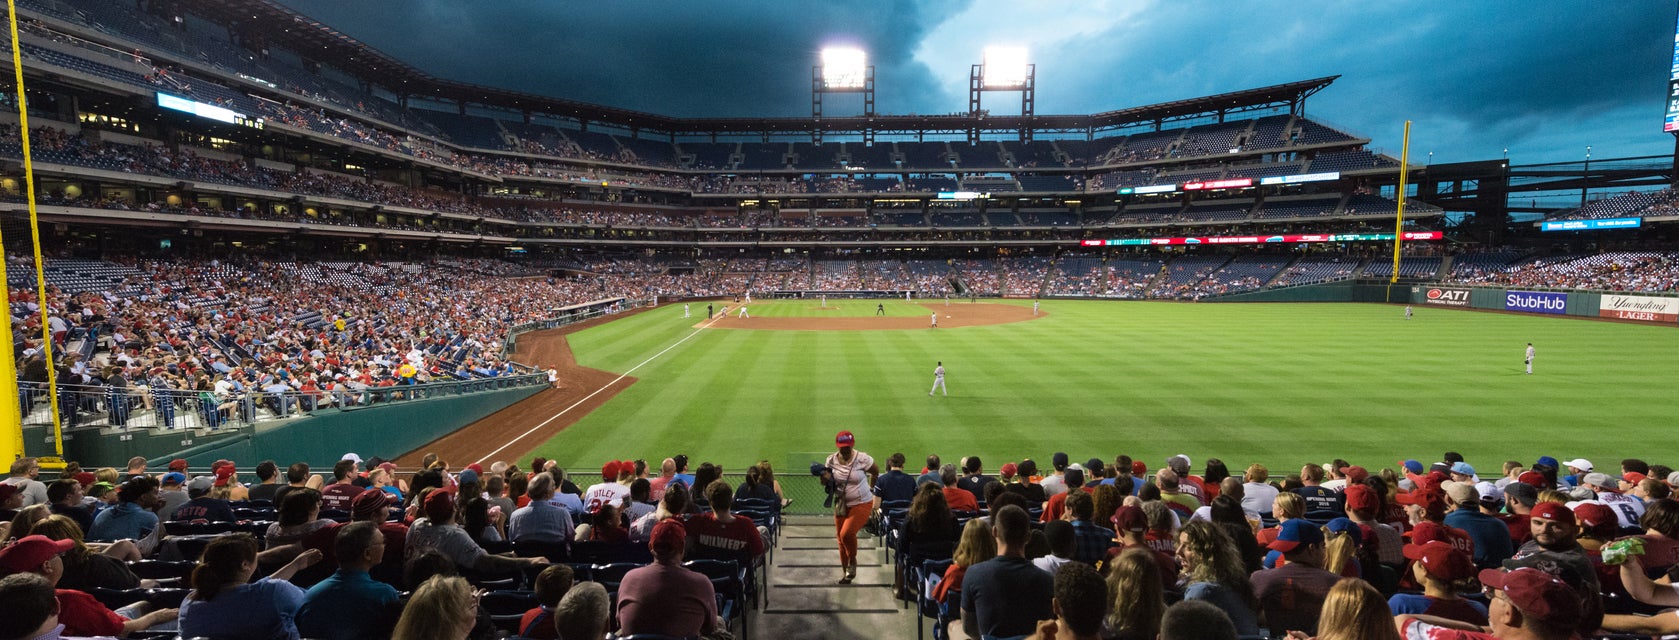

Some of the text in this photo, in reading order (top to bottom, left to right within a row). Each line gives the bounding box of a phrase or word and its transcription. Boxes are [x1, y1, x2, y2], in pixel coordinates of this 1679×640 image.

[1440, 290, 1469, 301] ATI
[1506, 294, 1565, 311] StubHub
[1608, 296, 1668, 313] Yuengling
[1619, 310, 1654, 321] LAGER
[594, 489, 615, 498] UTLEY
[1619, 503, 1640, 525] 6
